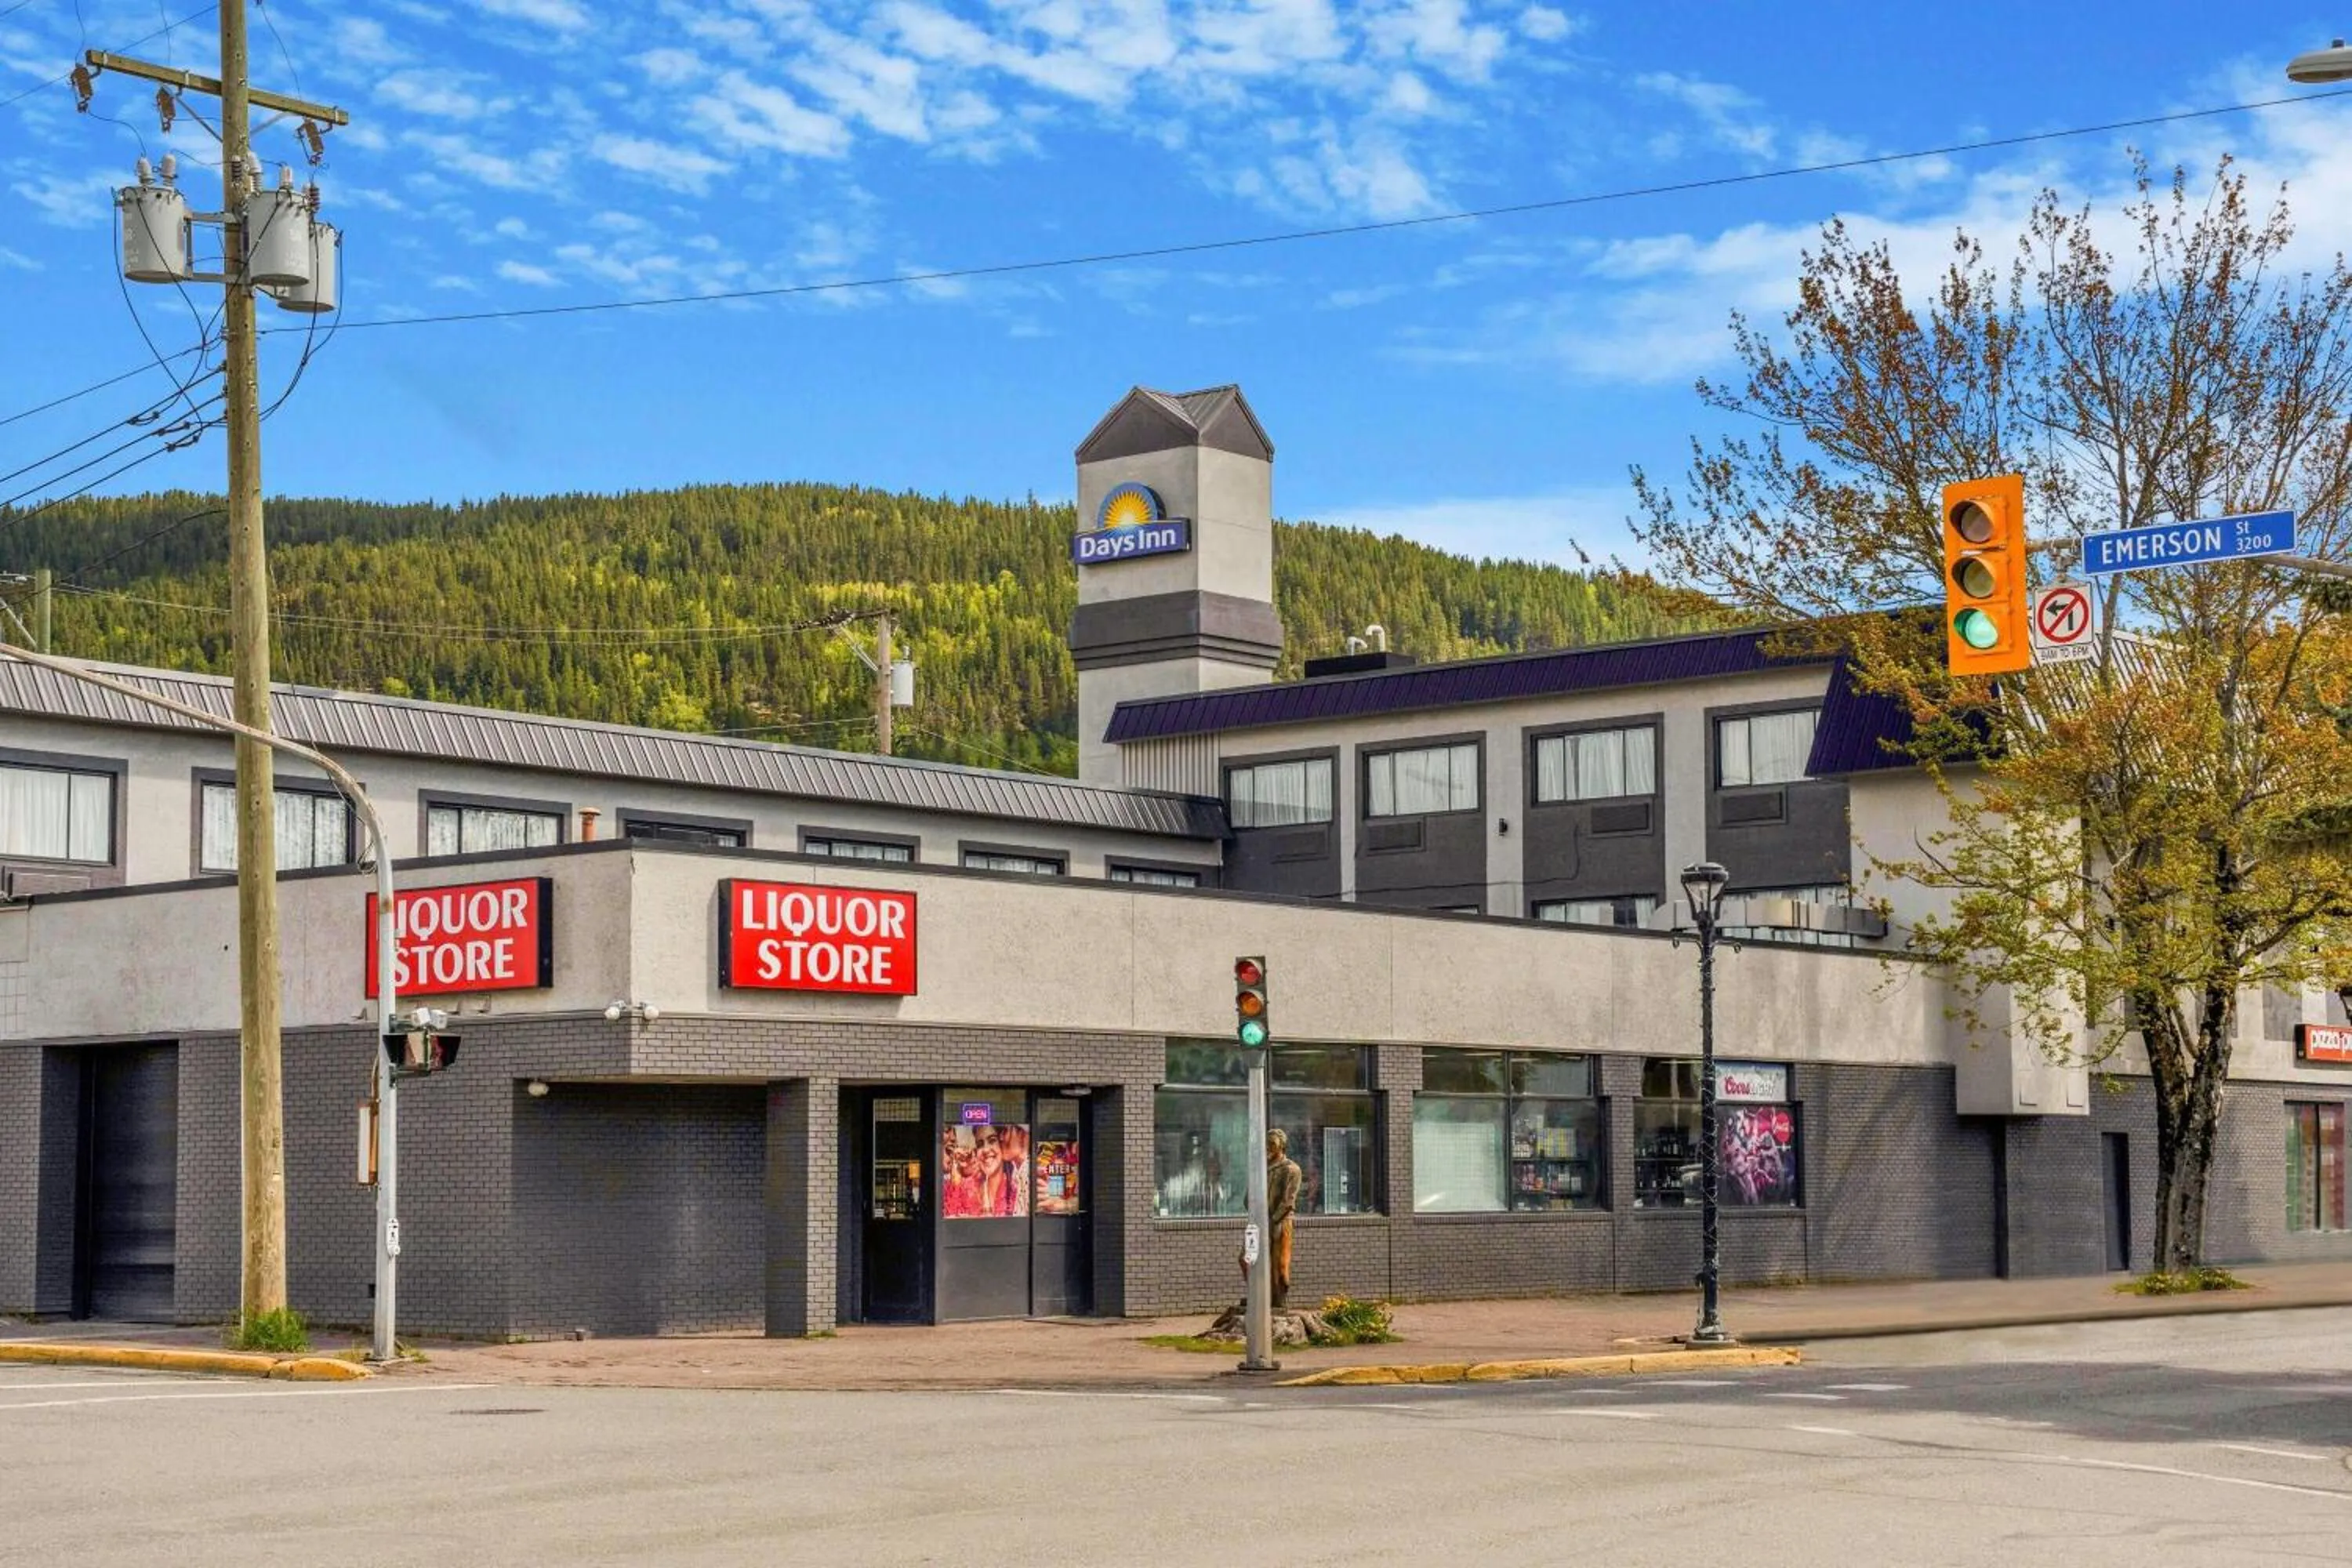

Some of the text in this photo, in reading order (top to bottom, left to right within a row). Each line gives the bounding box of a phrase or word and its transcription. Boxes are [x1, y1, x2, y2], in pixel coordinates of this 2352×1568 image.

[1080, 529, 1175, 557] Days Inn
[2102, 527, 2221, 564] EMERSON
[2236, 534, 2271, 551] 3200
[376, 888, 528, 941] IQUOR
[742, 889, 906, 938] LIQUOR
[393, 938, 515, 987] STORE
[757, 938, 892, 985] STORE
[965, 1109, 986, 1119] OPEN
